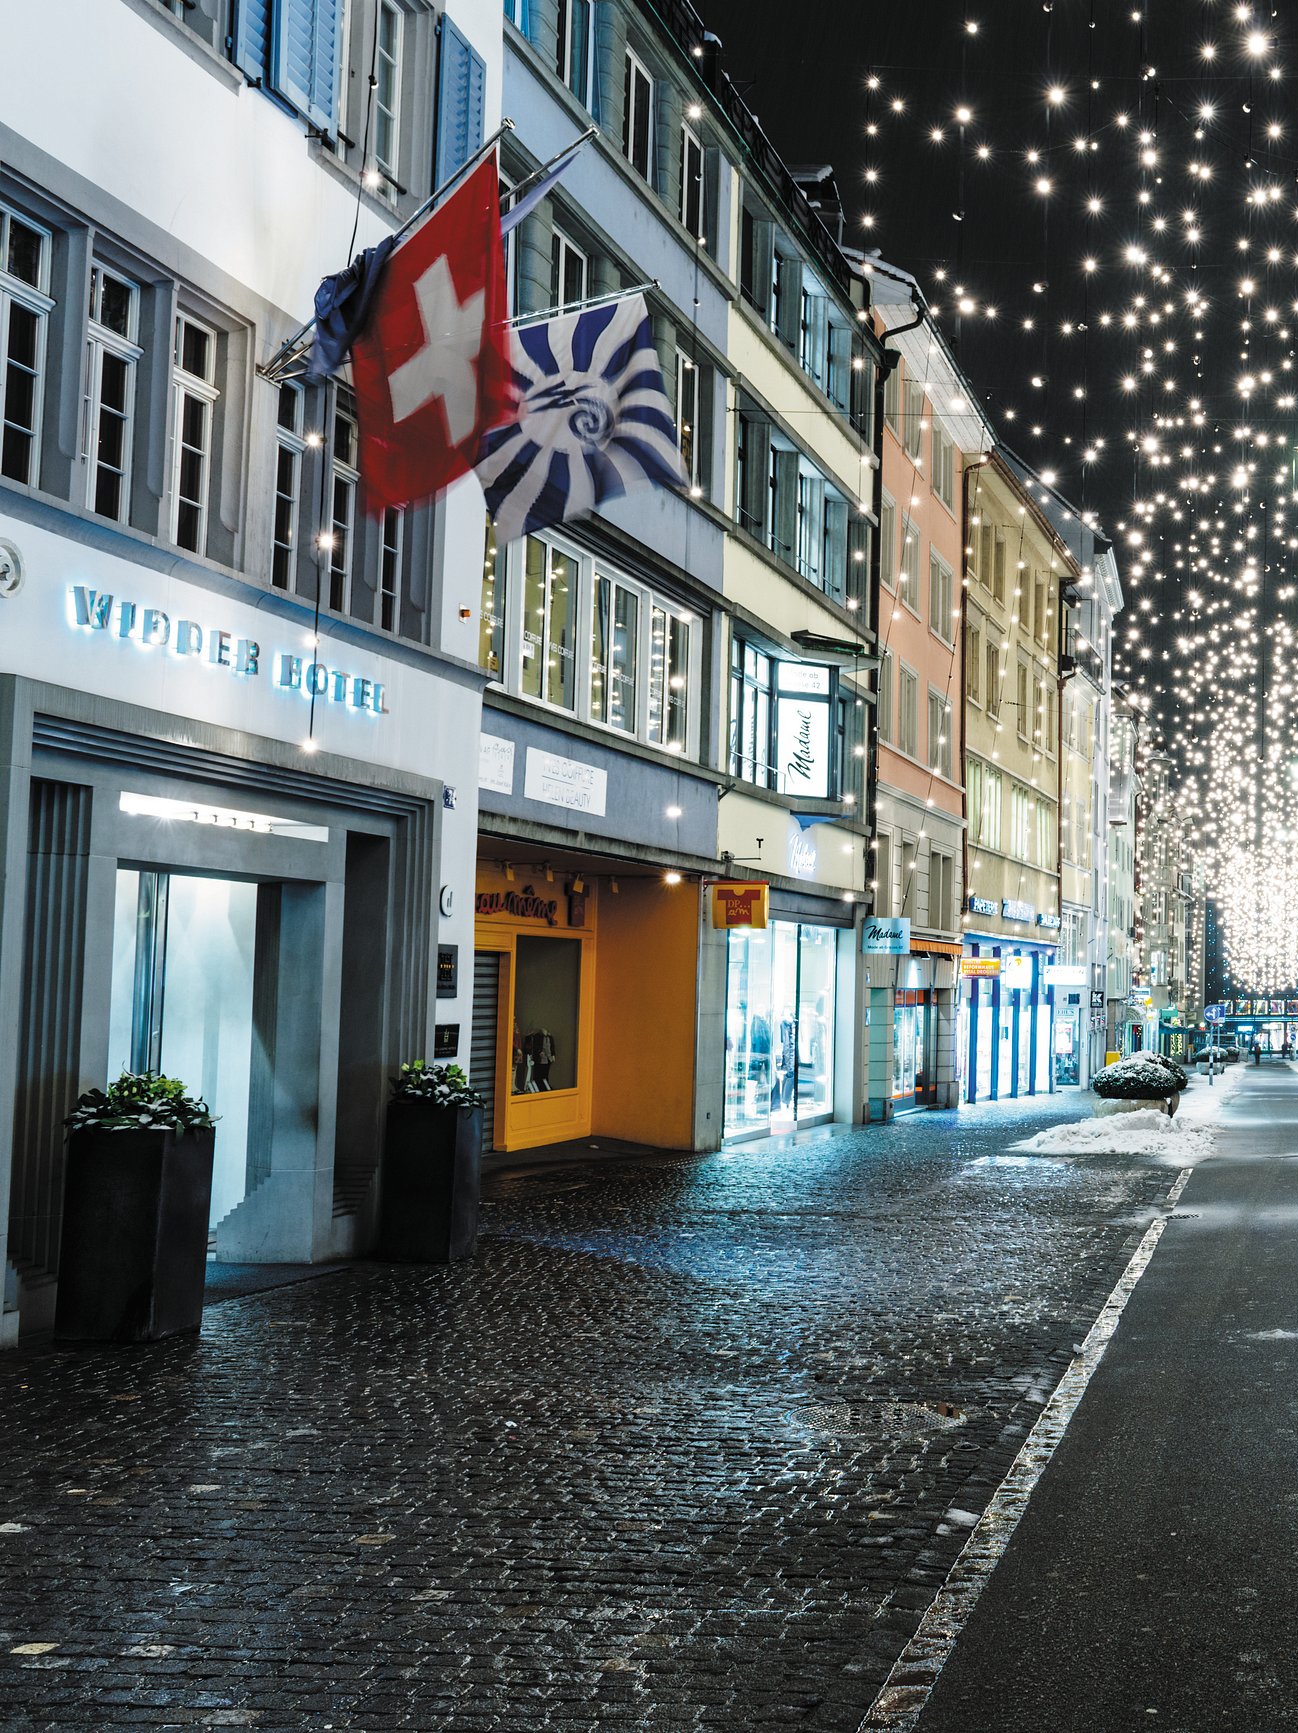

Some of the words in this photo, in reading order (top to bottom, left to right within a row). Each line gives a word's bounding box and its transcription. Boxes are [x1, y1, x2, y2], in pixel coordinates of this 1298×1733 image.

[73, 585, 261, 676] WIDDER
[279, 654, 390, 714] HOTEL
[787, 709, 815, 784] Madame
[866, 924, 904, 942] Madame
